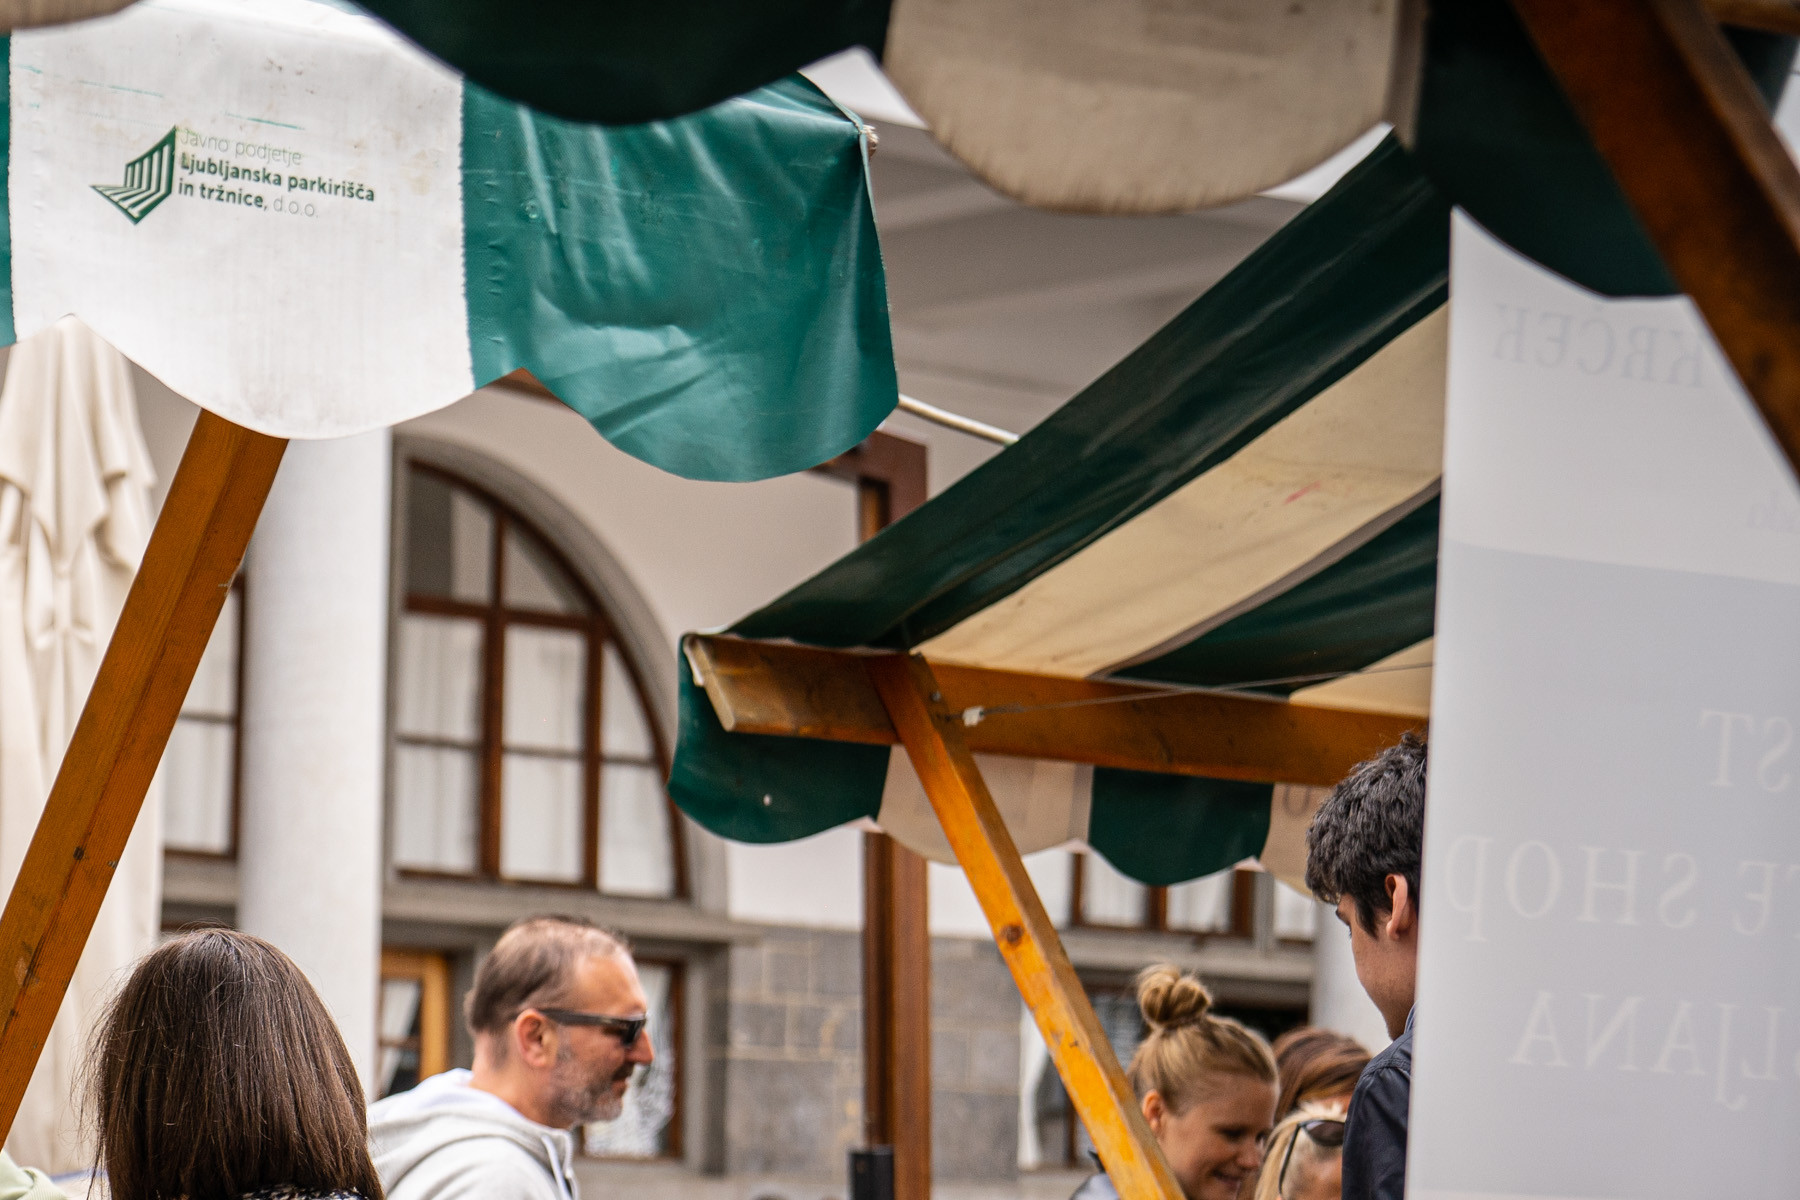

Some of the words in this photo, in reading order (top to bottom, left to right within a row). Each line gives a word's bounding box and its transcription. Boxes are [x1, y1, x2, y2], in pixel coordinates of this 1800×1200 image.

[234, 140, 302, 167] podjetje
[180, 152, 282, 186] Ljubljanska
[287, 174, 375, 201] parkirišča
[178, 178, 194, 196] in
[199, 182, 268, 210] tržnice,
[273, 196, 319, 218] d.o.o.
